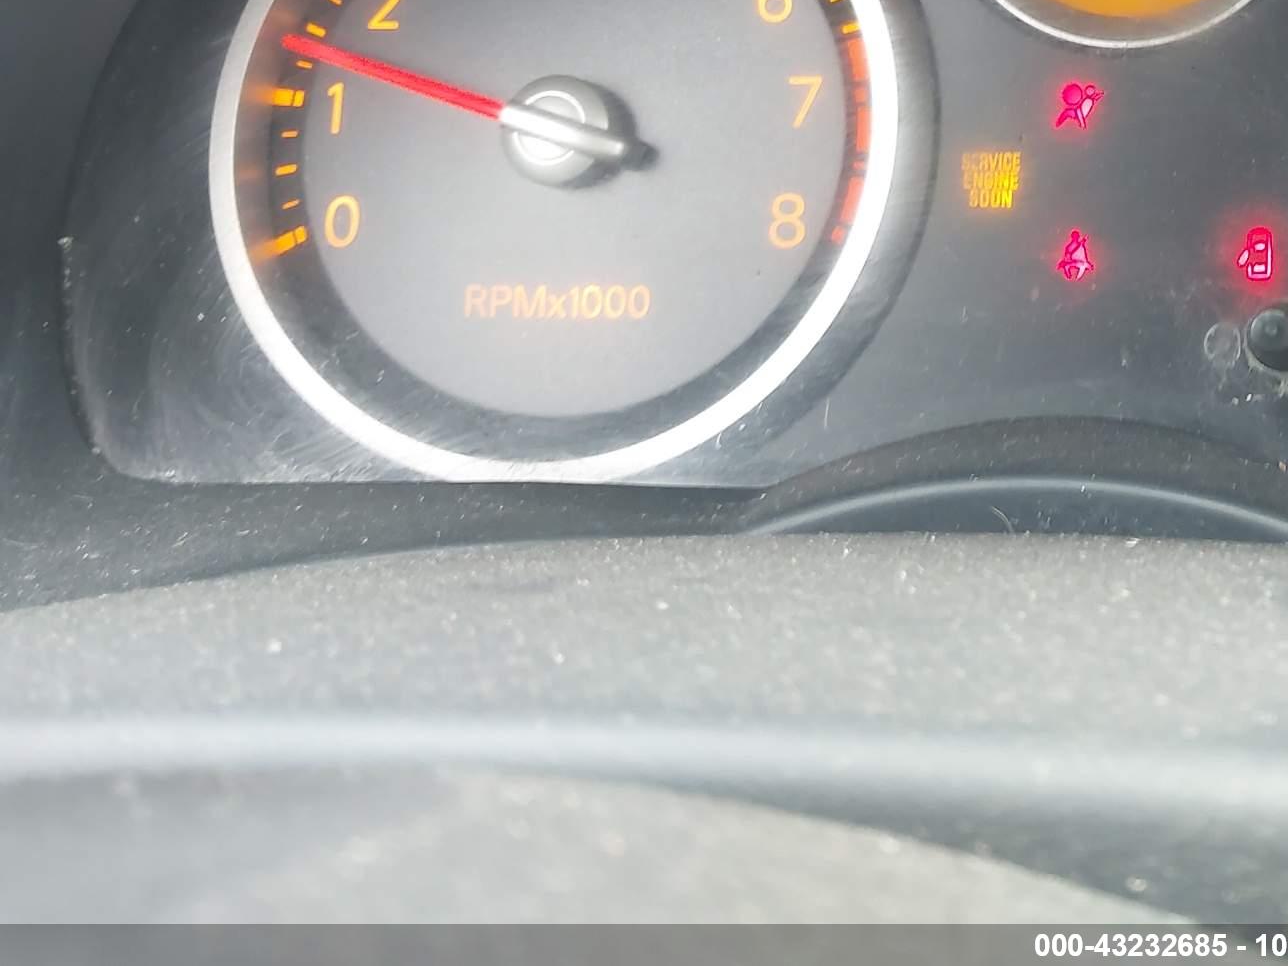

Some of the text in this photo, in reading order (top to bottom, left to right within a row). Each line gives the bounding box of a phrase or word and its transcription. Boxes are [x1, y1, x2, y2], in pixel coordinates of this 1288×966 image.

[326, 82, 344, 134] 1
[787, 76, 824, 128] 7
[324, 194, 360, 248] 0
[768, 193, 806, 249] 8
[463, 283, 652, 321] RPMx1000
